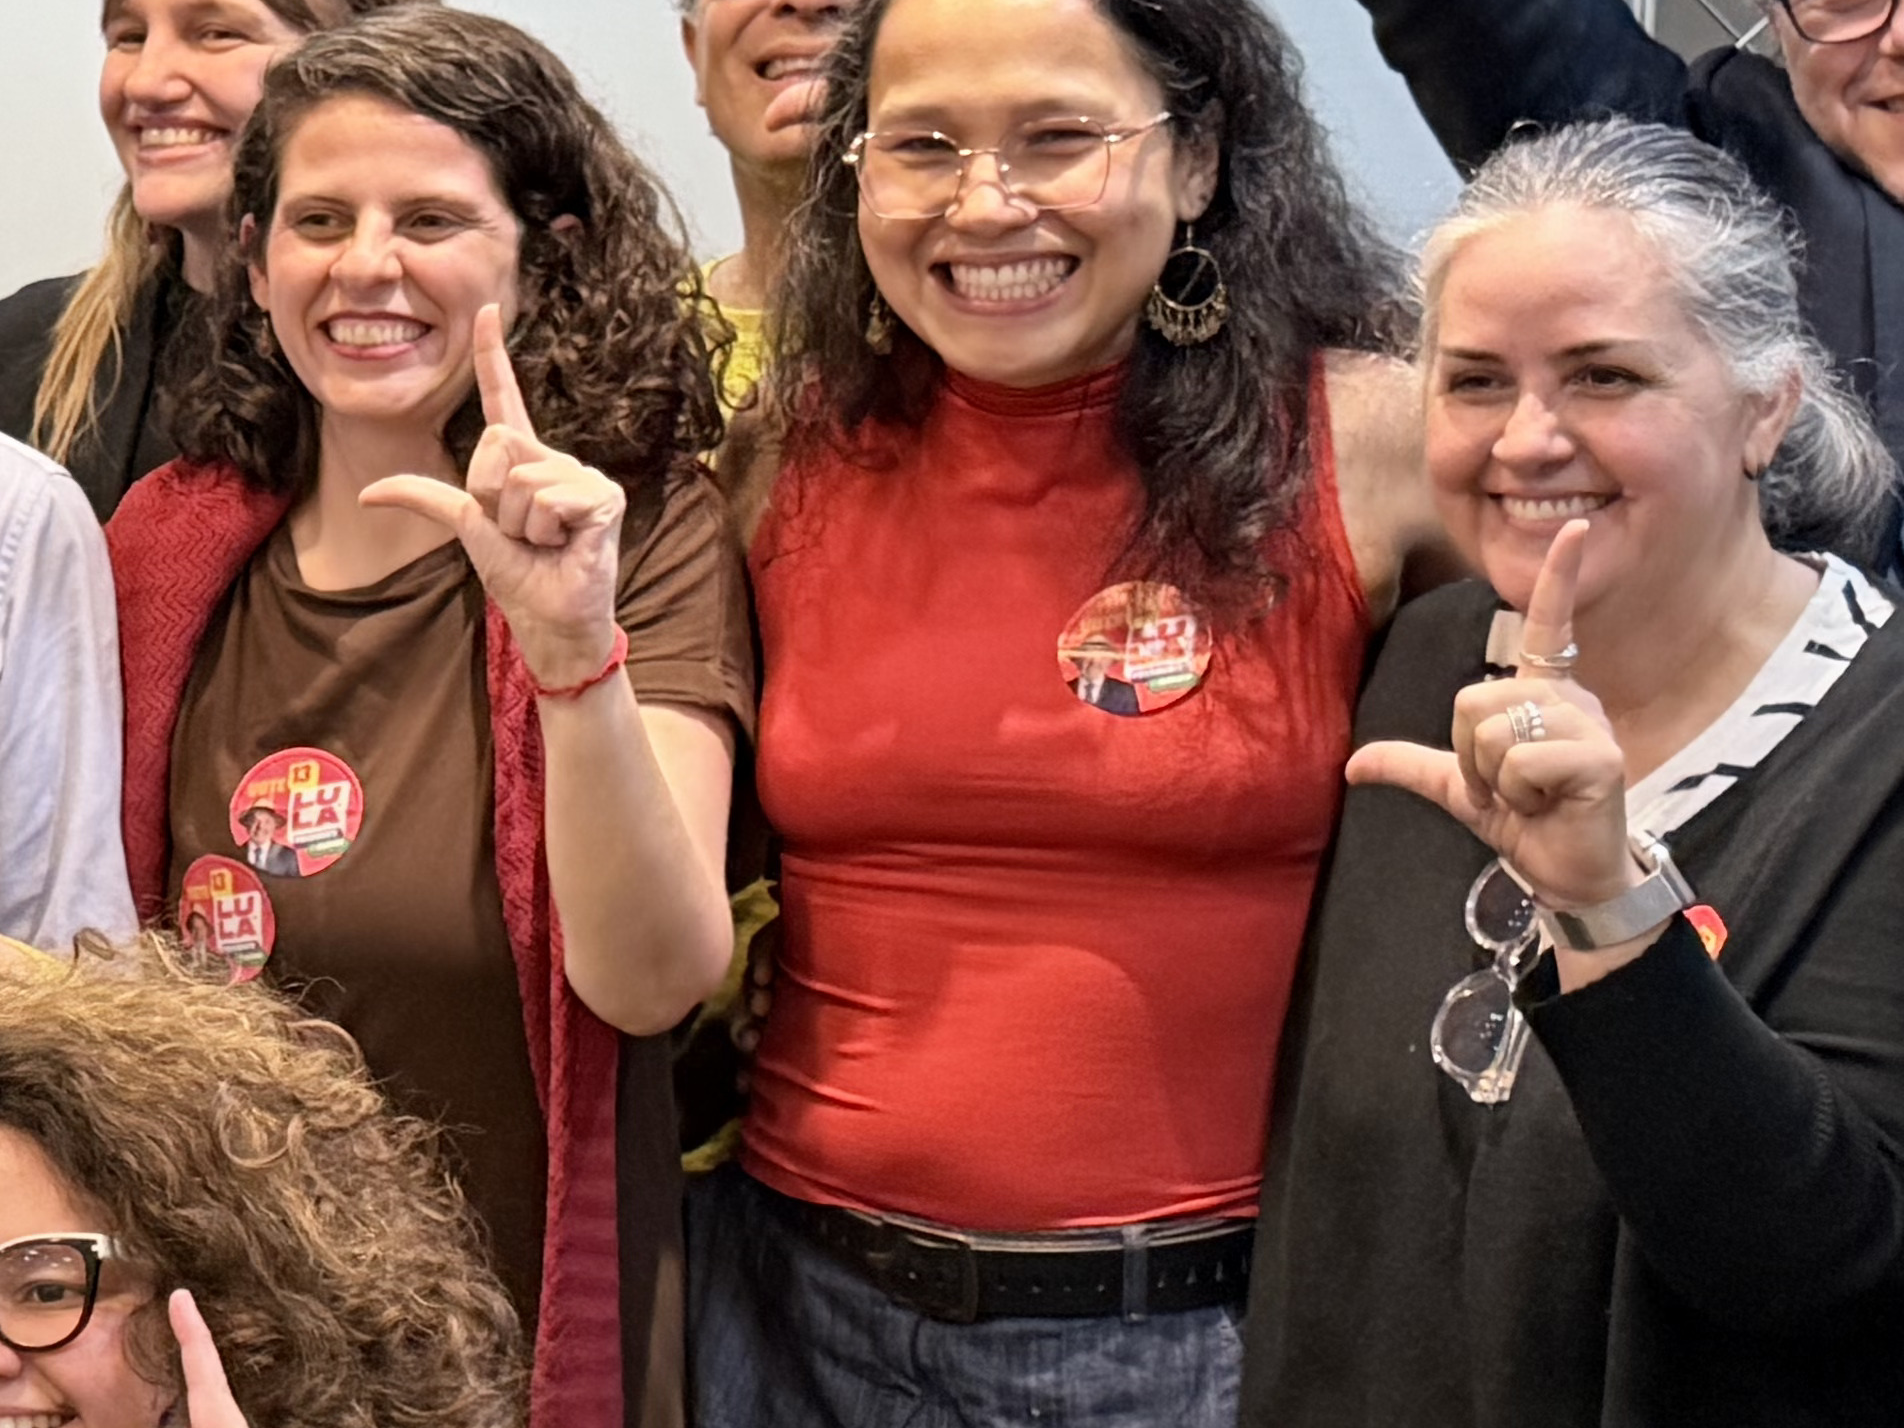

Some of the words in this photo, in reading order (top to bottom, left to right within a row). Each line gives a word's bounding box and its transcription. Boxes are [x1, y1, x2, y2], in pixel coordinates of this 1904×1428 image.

[293, 785, 342, 809] LU
[292, 807, 340, 830] LA
[217, 895, 255, 919] LU
[220, 918, 257, 940] LA
